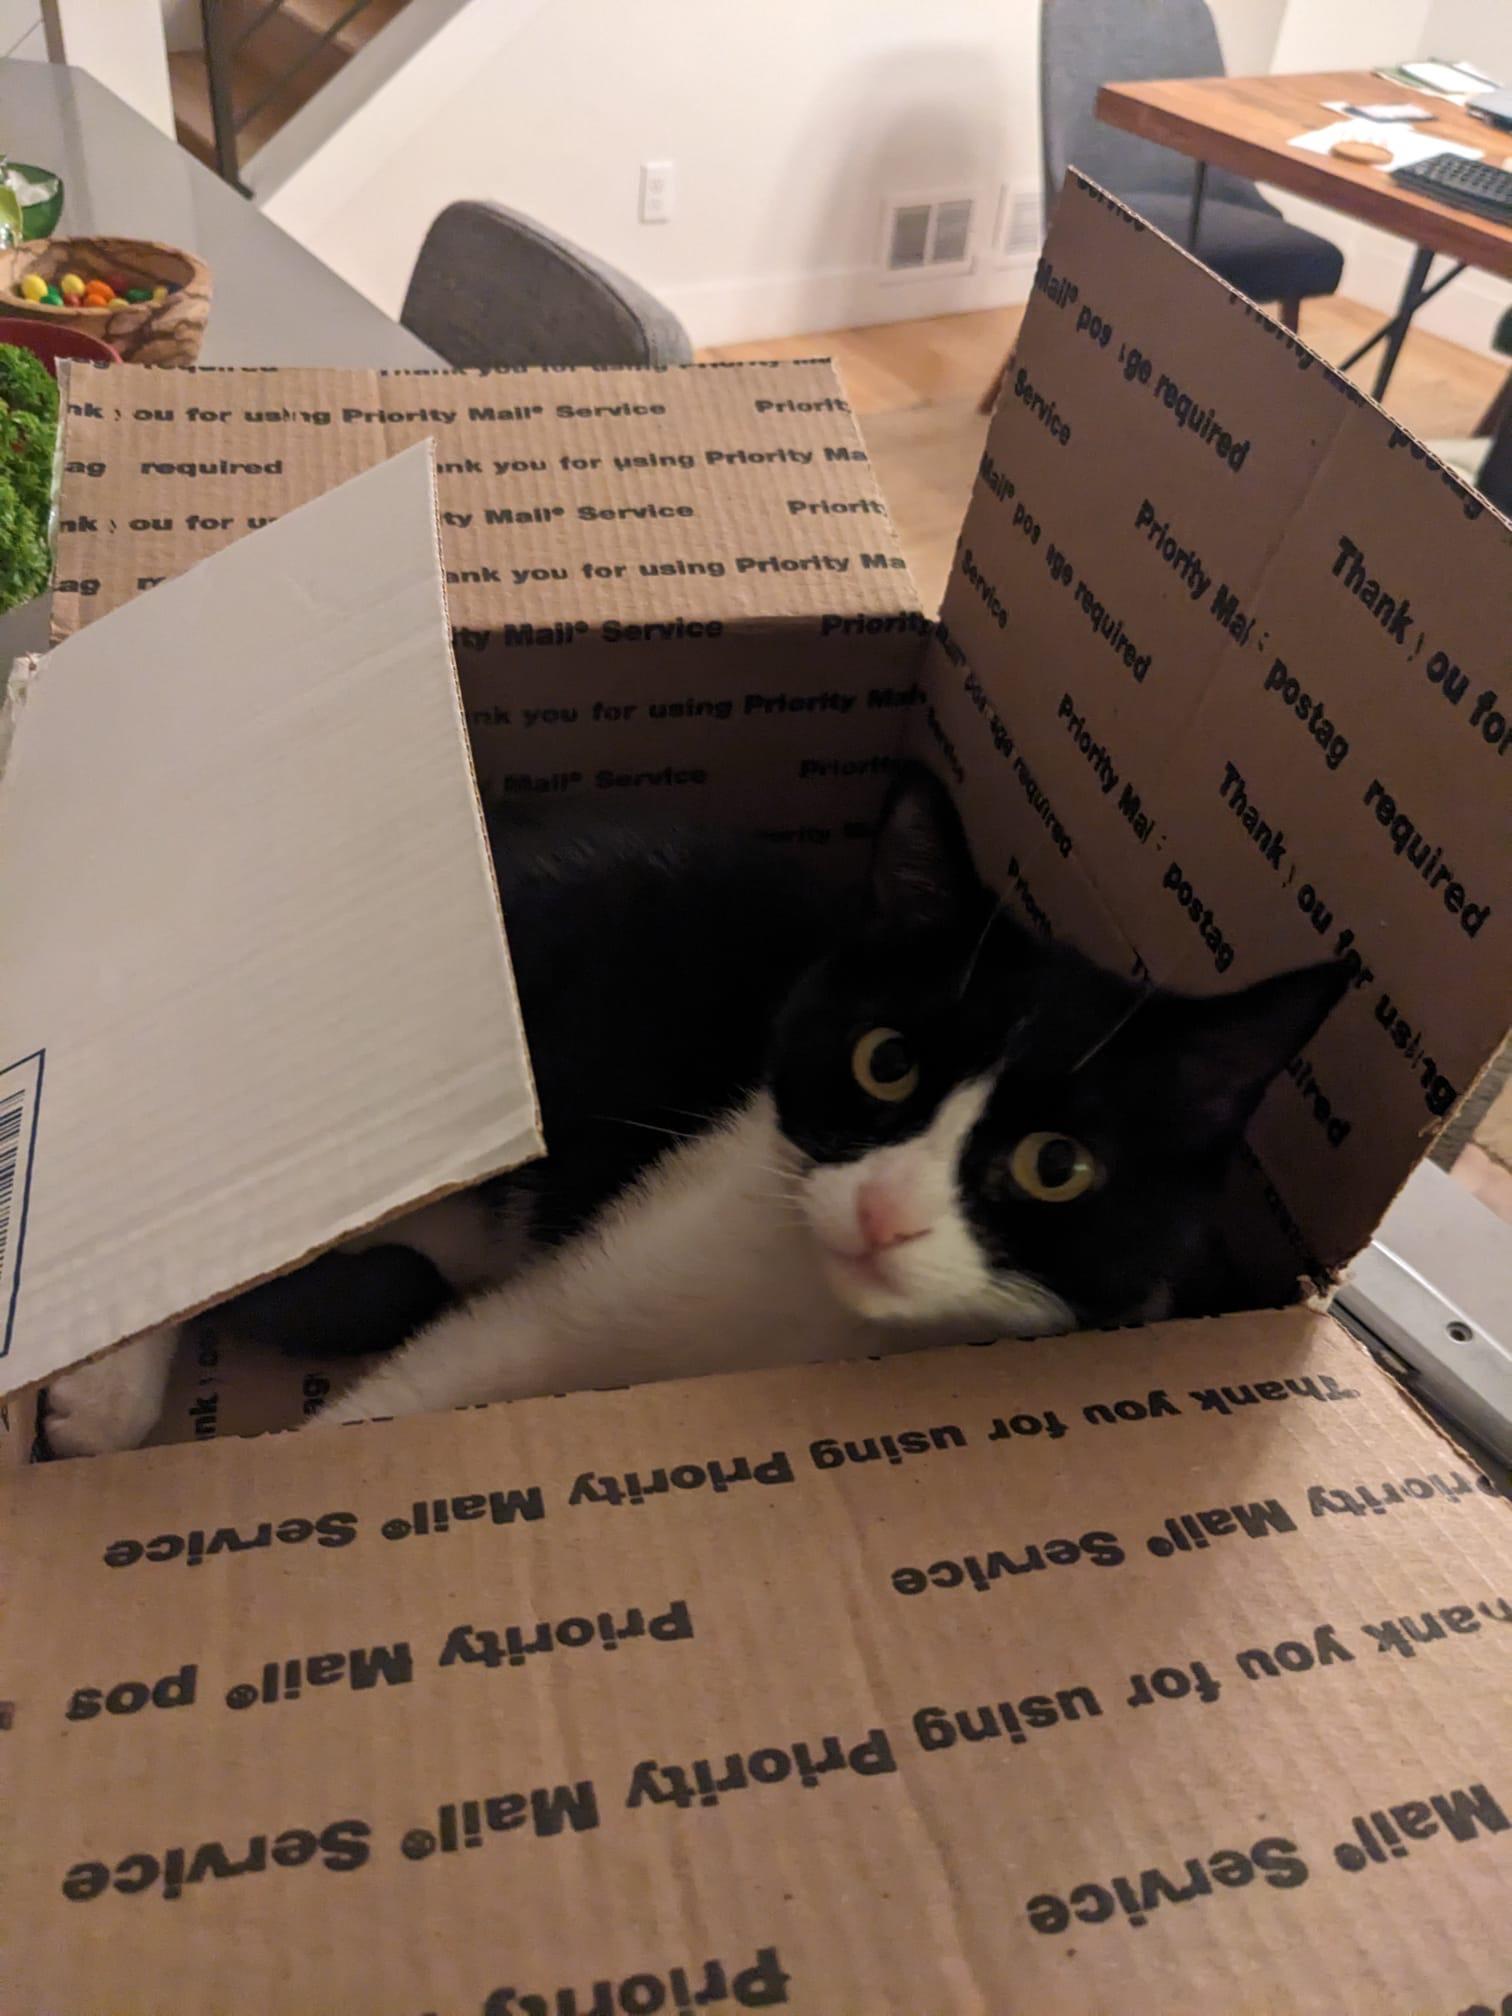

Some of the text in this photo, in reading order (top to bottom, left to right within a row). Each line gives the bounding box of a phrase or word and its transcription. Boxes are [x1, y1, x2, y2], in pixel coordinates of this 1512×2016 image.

[114, 407, 174, 423] ou
[186, 407, 232, 423] for
[245, 407, 331, 425] usng
[341, 407, 457, 425] Priority
[556, 403, 666, 419] Service
[1014, 368, 1072, 447] Service
[1154, 374, 1251, 473] required
[140, 459, 283, 477] required
[494, 459, 547, 476] you
[560, 456, 603, 471] for
[613, 453, 695, 472] using
[705, 448, 813, 466] Priority
[110, 517, 173, 534] ou
[186, 515, 234, 531] for
[577, 504, 694, 521] Service
[512, 567, 569, 584] you
[582, 563, 627, 579] for
[639, 560, 726, 577] using
[735, 555, 850, 573] Priority
[962, 548, 1008, 629] Service
[602, 617, 724, 643] Service
[1074, 580, 1152, 684] required
[1331, 535, 1414, 644] Thank
[1407, 632, 1470, 705] ou
[523, 706, 578, 728] you
[592, 701, 638, 722] for
[648, 698, 733, 722] using
[744, 693, 856, 716] Priority
[1134, 500, 1212, 600] Priority
[1363, 778, 1490, 938] required
[1058, 693, 1119, 794] Priority
[595, 766, 708, 789] Service
[1219, 761, 1286, 870] Thank
[1282, 864, 1334, 934] ou
[1082, 1389, 1182, 1425] you
[1189, 1373, 1361, 1416] Thank
[808, 1424, 969, 1470] using
[988, 1410, 1071, 1442] for
[568, 1451, 796, 1507] Priority
[103, 1511, 359, 1568] Service
[890, 1530, 1126, 1596] Service
[438, 1599, 695, 1668] Priority
[1235, 1623, 1356, 1681] you
[1126, 1660, 1222, 1709] for
[911, 1684, 1104, 1753] using
[625, 1727, 898, 1809] Priority
[62, 1819, 372, 1903] Service
[1026, 1836, 1310, 1935] Service
